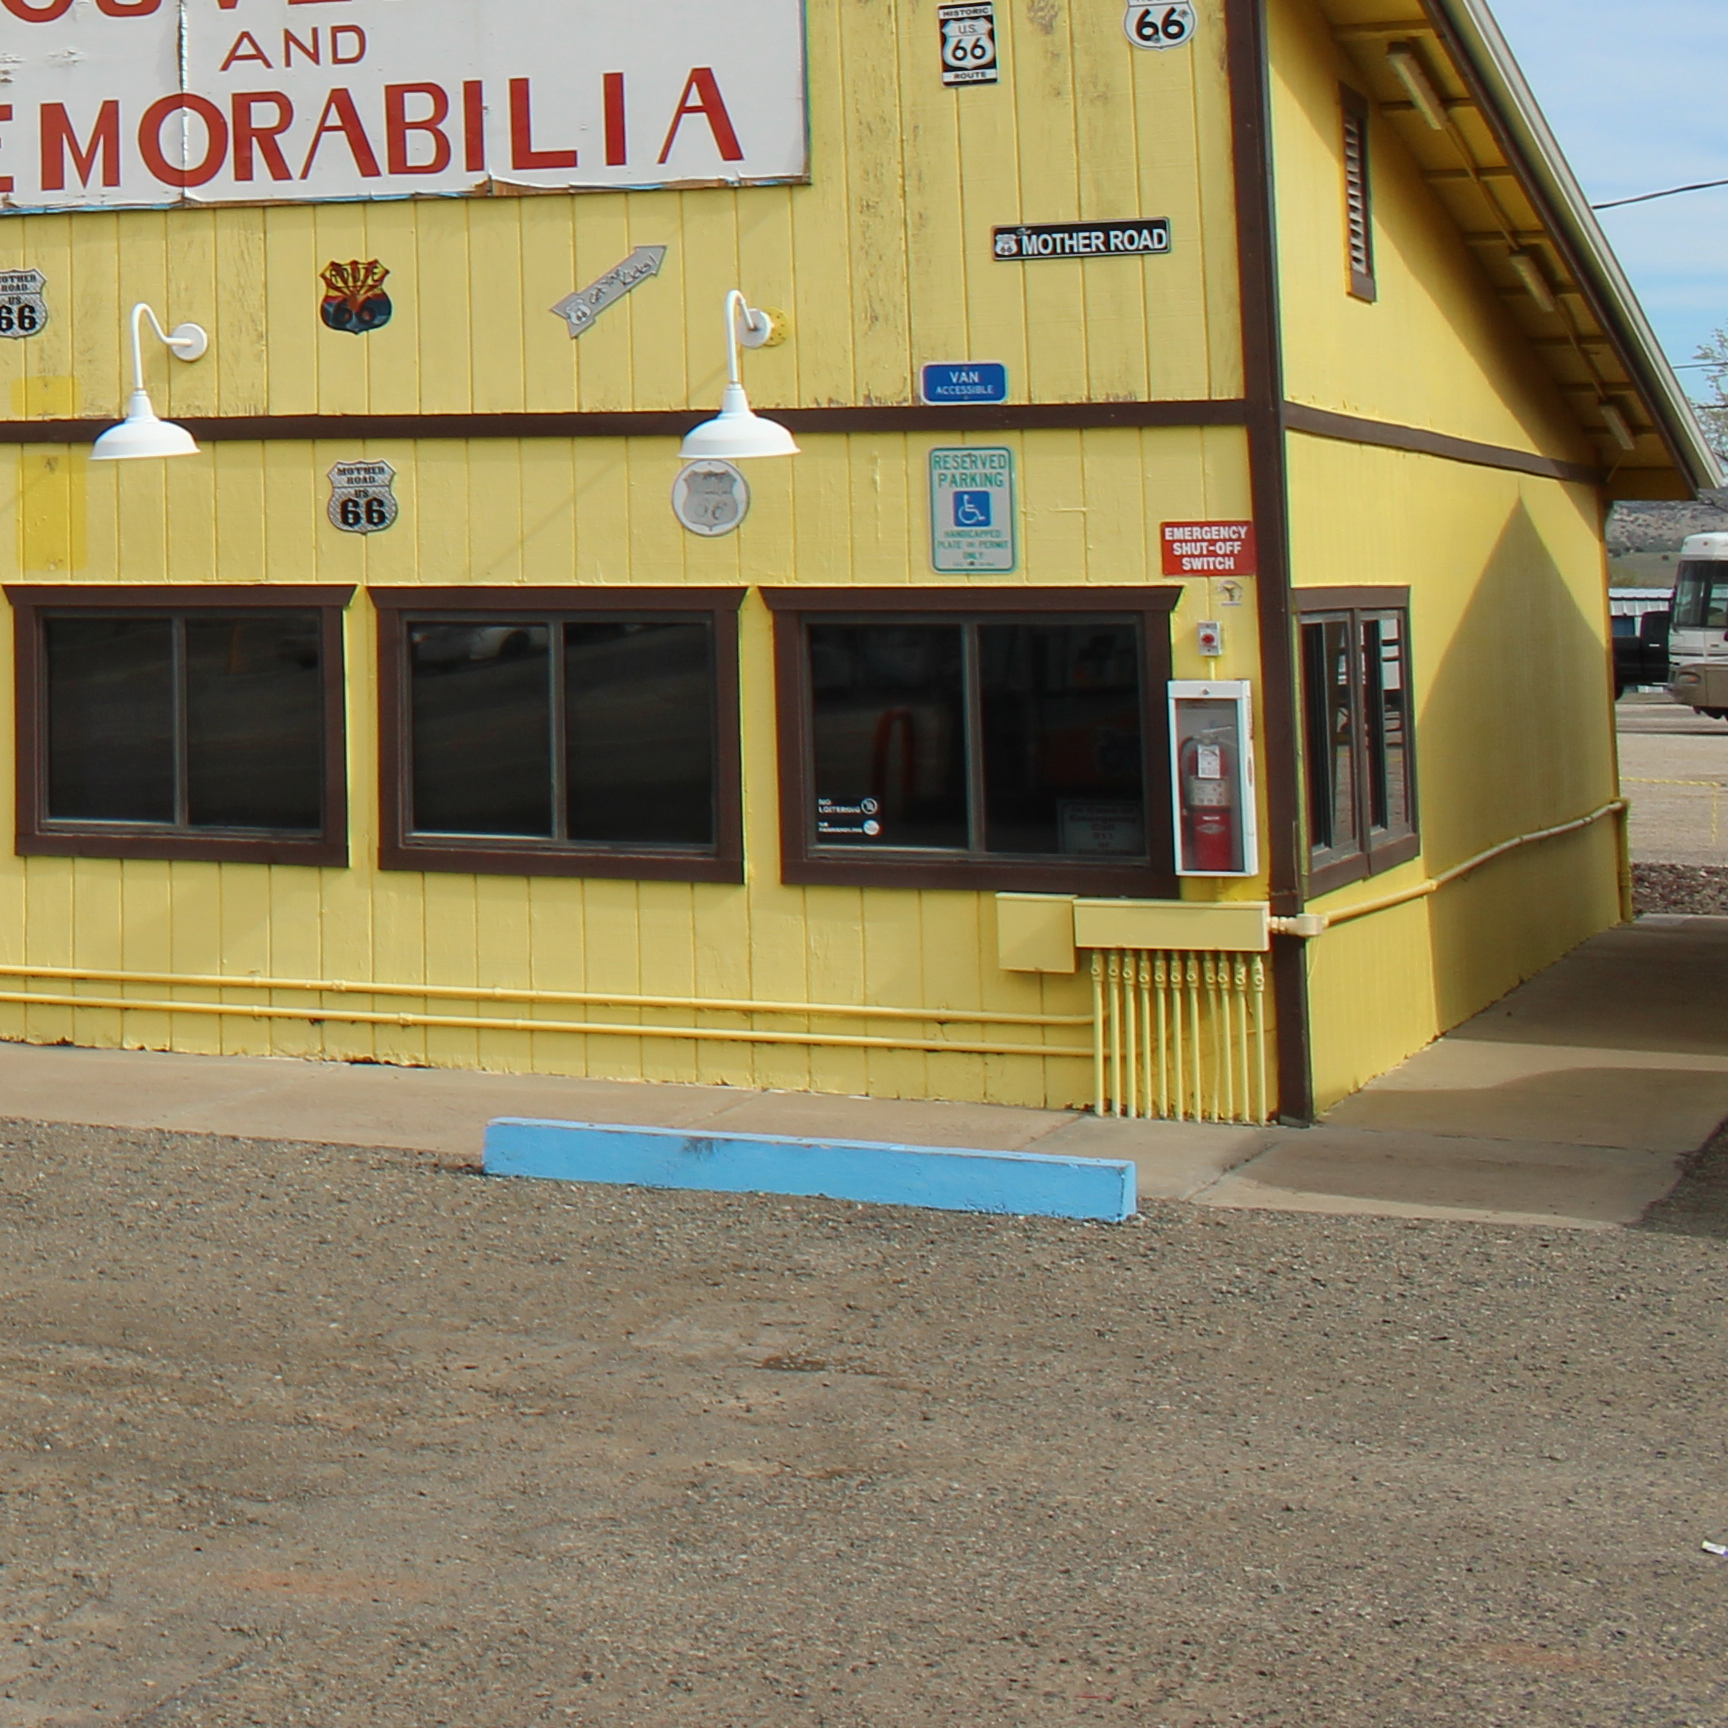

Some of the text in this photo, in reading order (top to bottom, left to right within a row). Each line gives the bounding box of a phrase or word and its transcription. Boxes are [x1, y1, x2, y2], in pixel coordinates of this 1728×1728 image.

[943, 7, 989, 18] HISTORIC
[1135, 6, 1186, 42] 66
[219, 22, 368, 73] AND
[951, 37, 987, 61] 66
[953, 71, 987, 79] ROUTE
[1021, 231, 1106, 255] MOTHER
[1108, 228, 1168, 251] ROAD
[330, 265, 379, 284] ROUTE
[0, 284, 29, 292] ROAD
[8, 296, 22, 305] US
[330, 297, 378, 326] 66
[948, 371, 980, 383] VAN
[935, 384, 994, 395] ACCESSIBLE
[933, 454, 1008, 471] RESERVED
[336, 466, 386, 475] MOTHER
[346, 476, 376, 485] ROAD
[938, 472, 1004, 488] PARKING
[354, 489, 370, 498] US
[340, 497, 386, 528] 66
[944, 529, 1002, 539] HANDICAPPED
[1164, 526, 1248, 541] EMERGENCY
[937, 540, 962, 549] PLATE
[978, 539, 1009, 549] PERMIT
[1172, 541, 1242, 556] SHUT-OFF
[962, 551, 984, 560] ONLY
[1181, 557, 1235, 571] SWITCH
[1068, 814, 1138, 824] Emergency
[1091, 823, 1115, 831] Call
